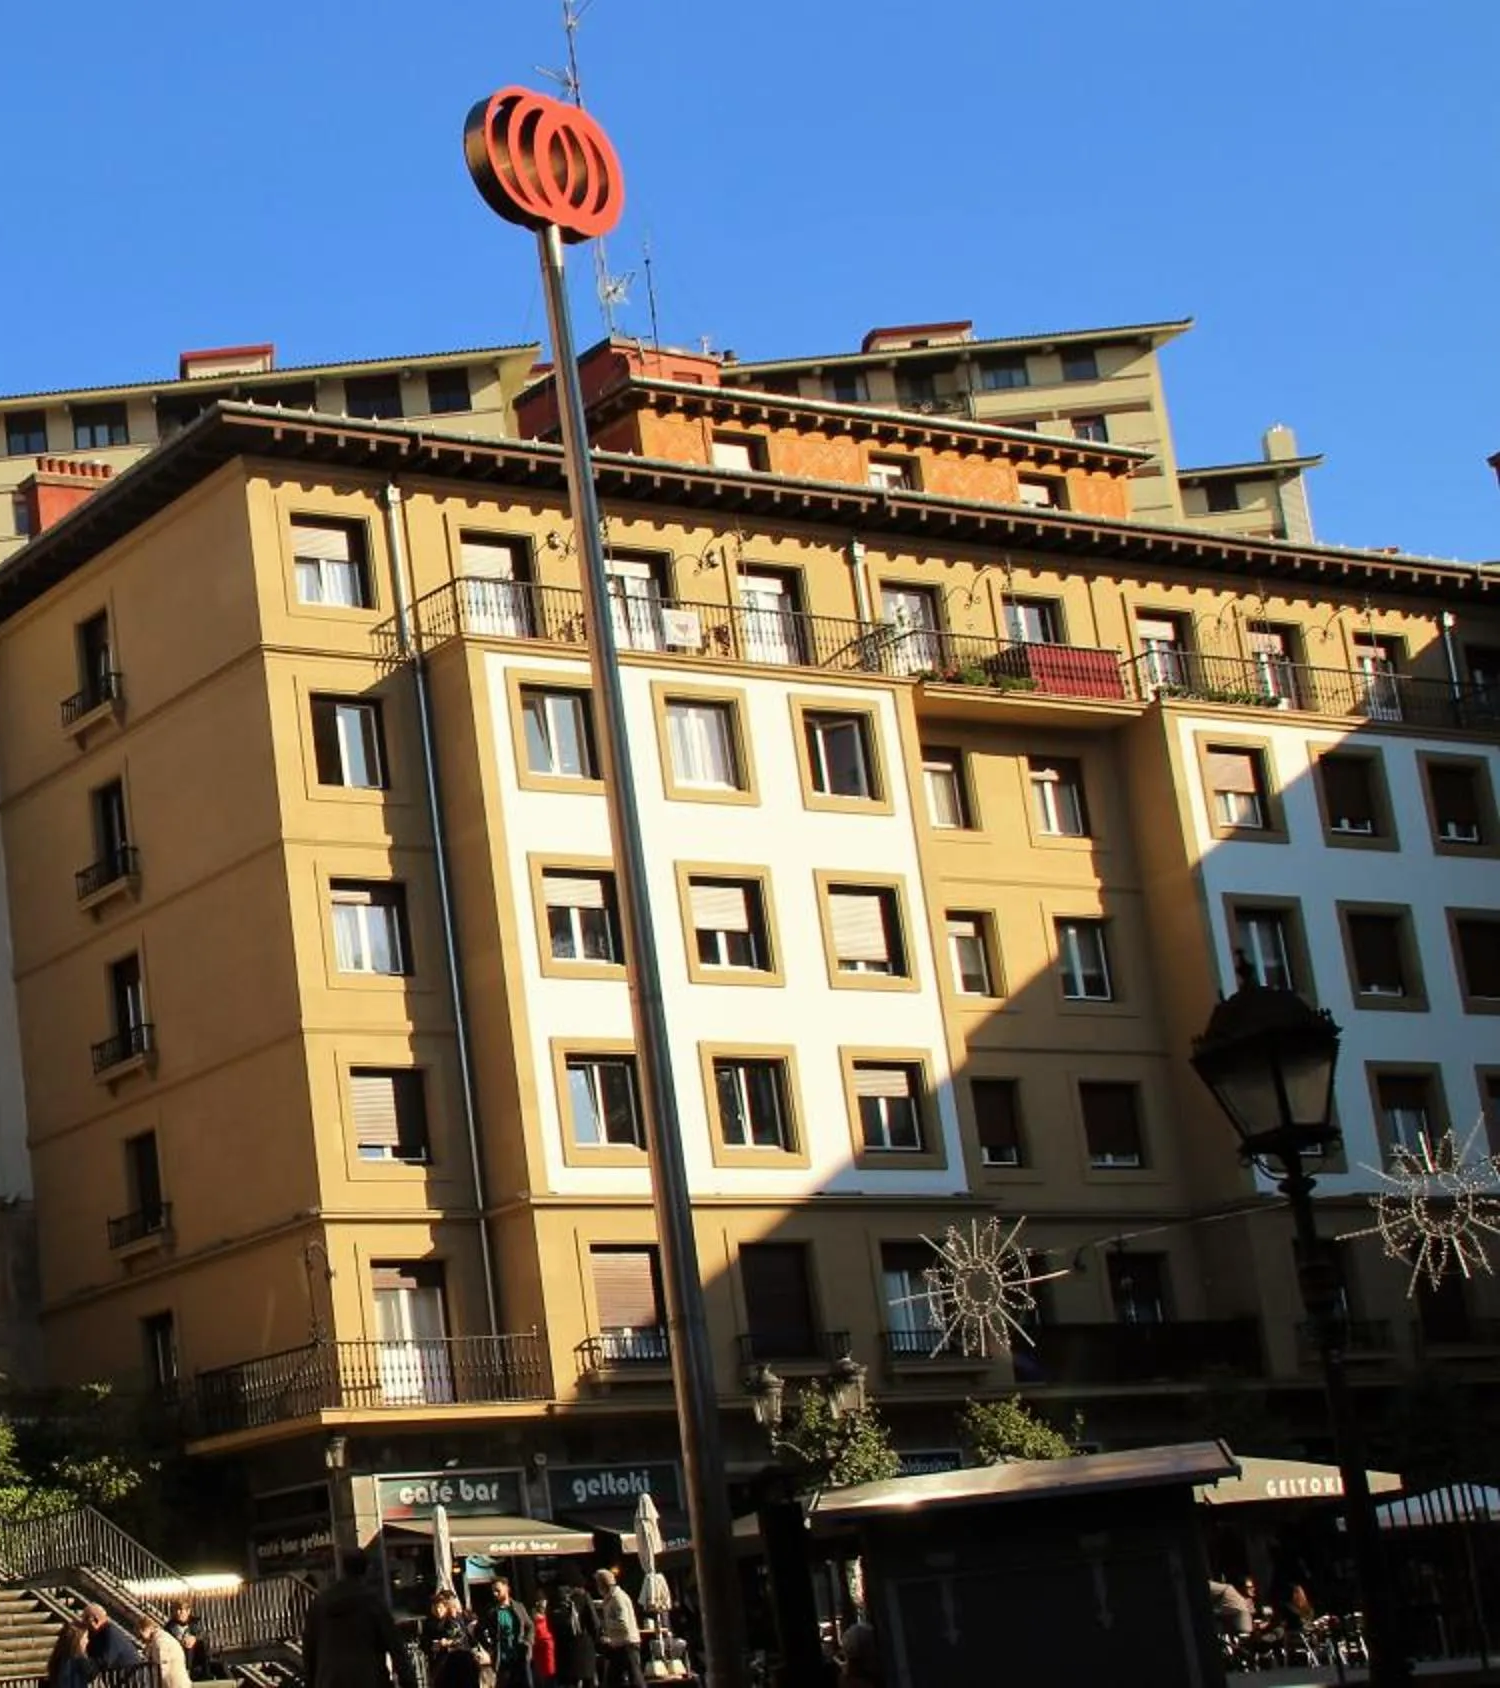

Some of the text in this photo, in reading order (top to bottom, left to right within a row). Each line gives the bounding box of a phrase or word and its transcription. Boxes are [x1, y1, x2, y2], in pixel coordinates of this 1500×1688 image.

[400, 1479, 499, 1505] café bar
[572, 1470, 651, 1502] geltoki
[529, 1540, 558, 1552] bar
